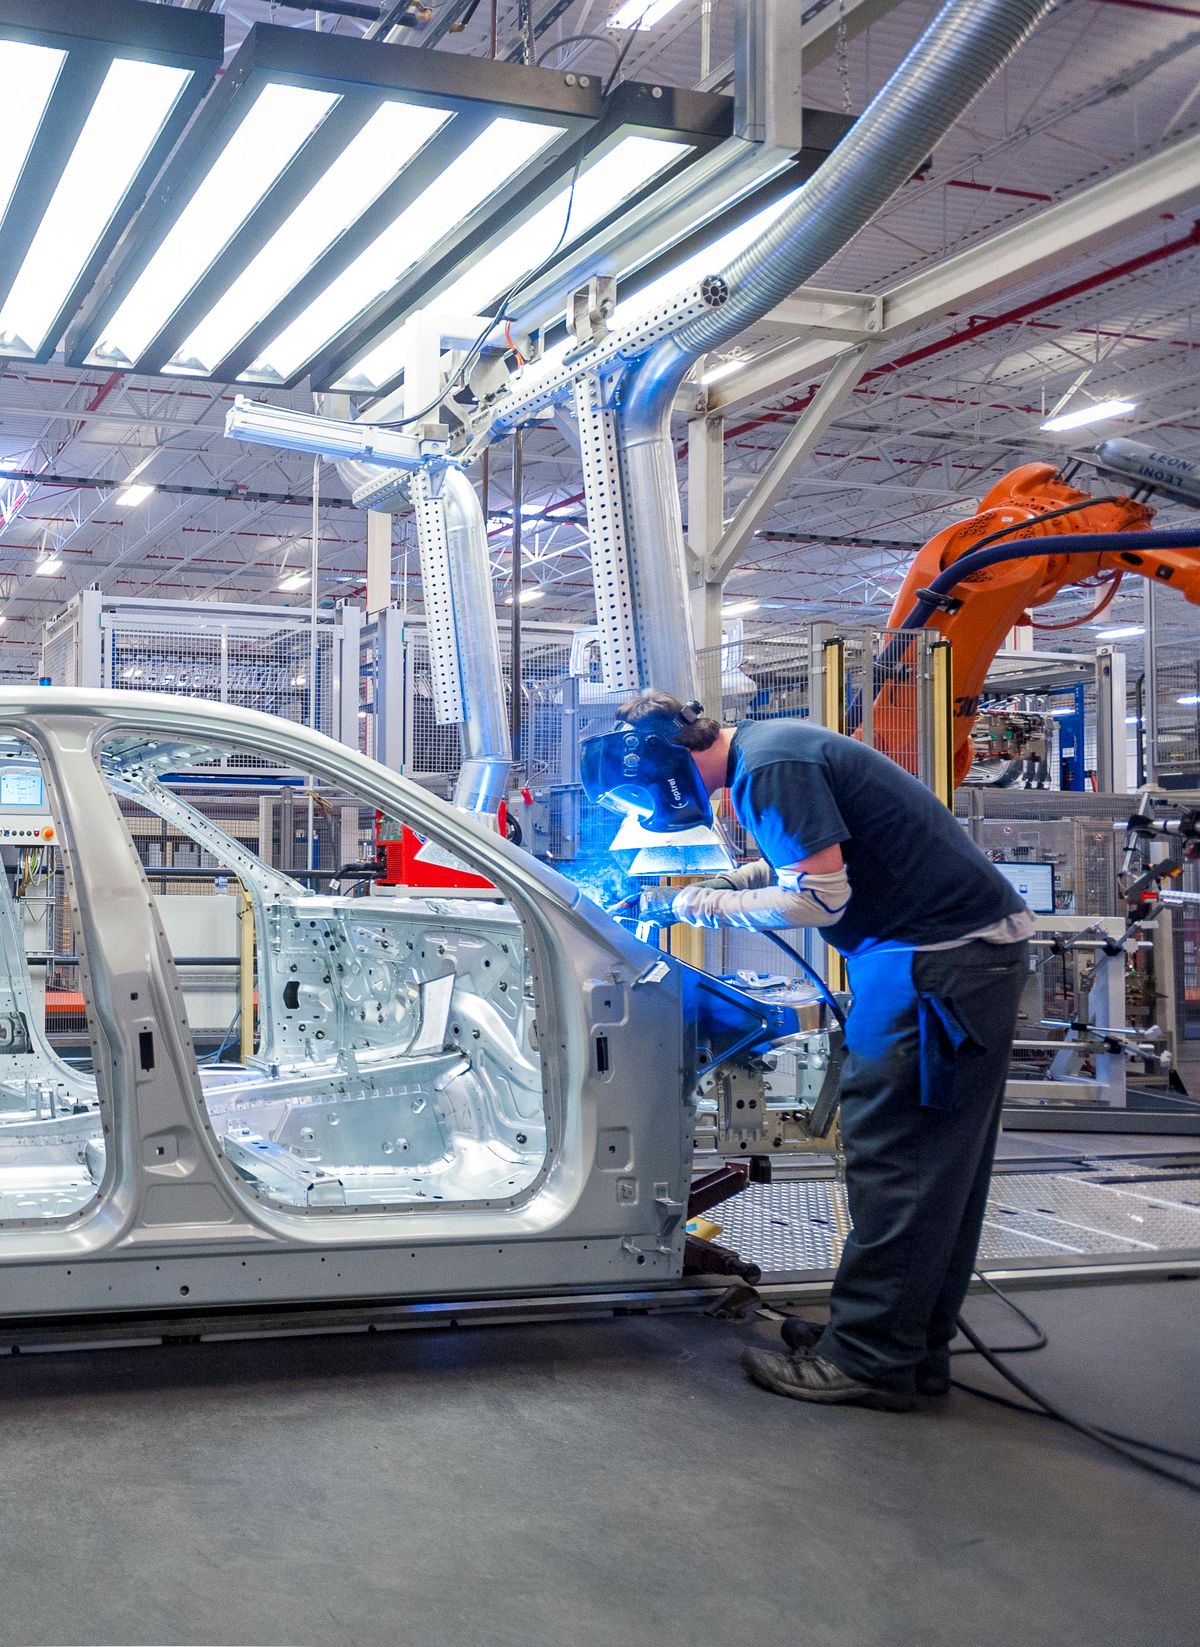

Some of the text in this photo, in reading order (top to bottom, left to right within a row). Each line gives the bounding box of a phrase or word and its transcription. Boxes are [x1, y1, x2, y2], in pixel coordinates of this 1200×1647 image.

[1149, 452, 1197, 472] LEONI
[1138, 465, 1183, 487] LEONI
[667, 778, 681, 801] optrel
